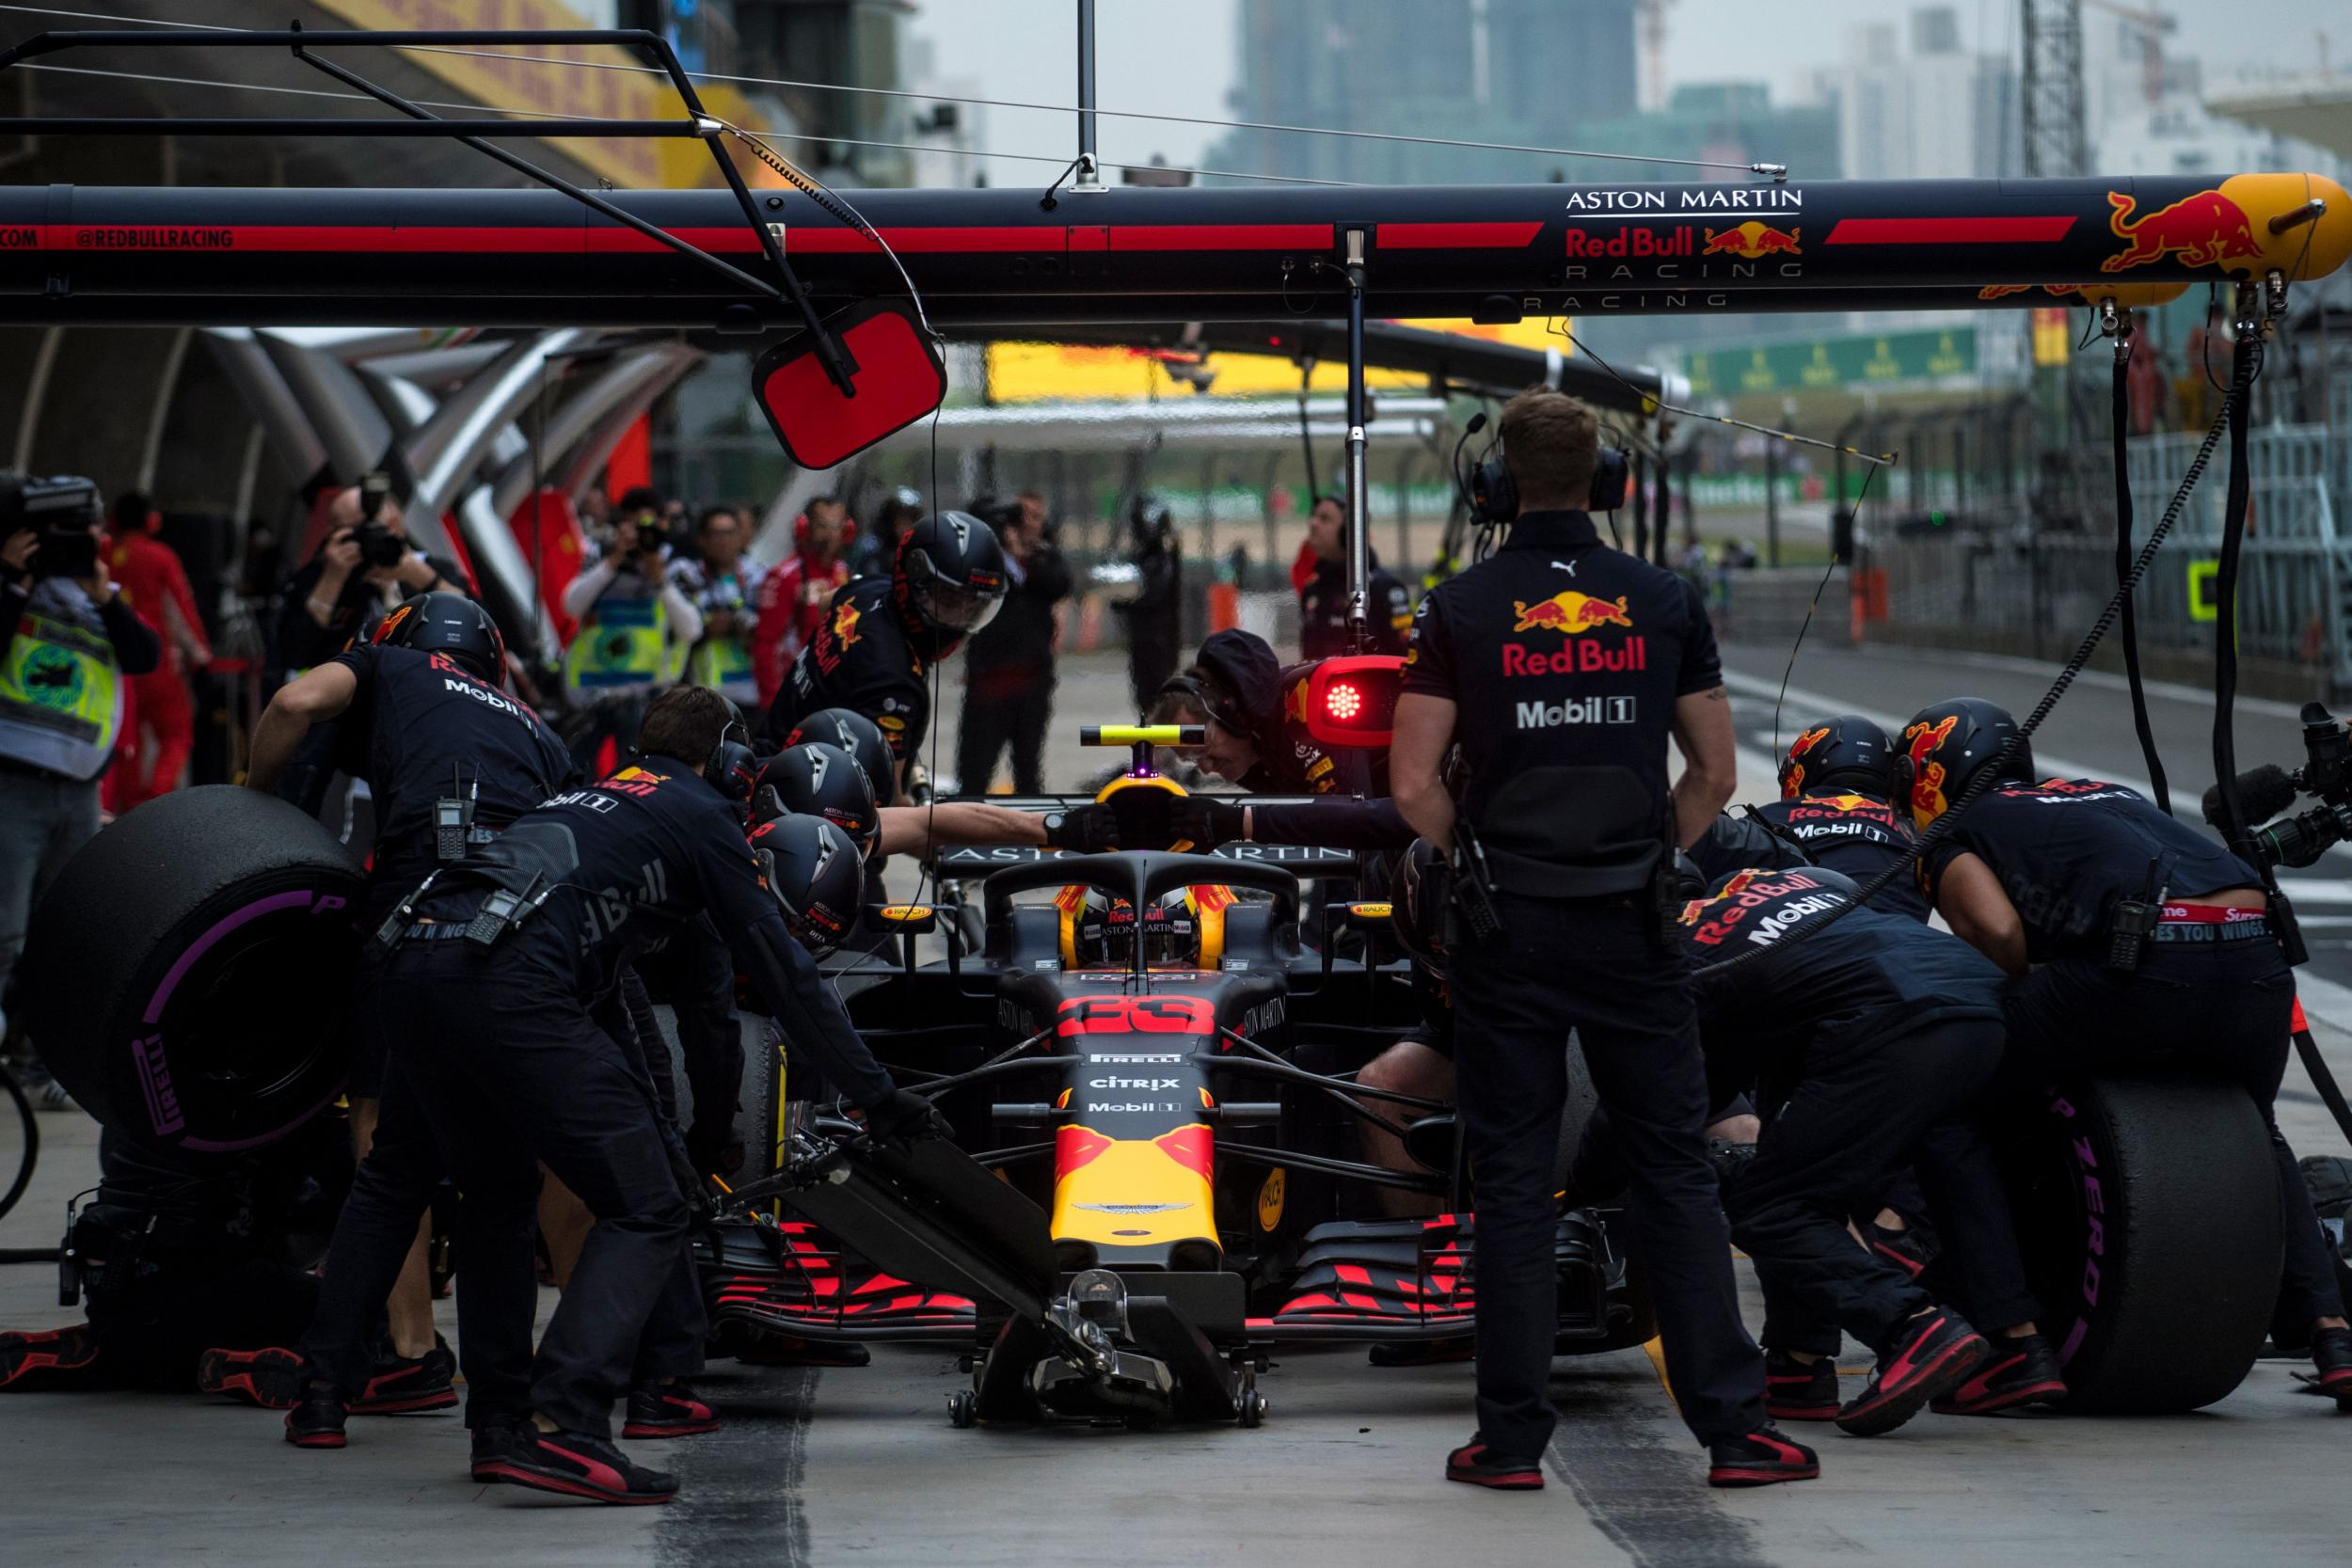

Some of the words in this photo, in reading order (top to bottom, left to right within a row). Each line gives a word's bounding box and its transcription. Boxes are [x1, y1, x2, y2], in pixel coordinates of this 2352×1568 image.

[1566, 191, 1665, 210] ASTON
[1680, 189, 1803, 208] MARTIN
[76, 230, 233, 248] @REDBULLRACING
[1565, 227, 1628, 258] Red
[1632, 225, 1692, 257] Bull
[1566, 263, 1803, 279] RACING
[1523, 293, 1726, 309] RACING
[1502, 637, 1574, 677] Red
[1578, 635, 1645, 673] Bull
[444, 678, 518, 716] Mobil
[1516, 696, 1603, 730] Mobil
[1793, 823, 1863, 839] Mobil
[947, 847, 1069, 861] AST
[1208, 847, 1352, 860] ARTIN
[1145, 906, 1164, 921] ull
[1693, 893, 1770, 945] Red
[1749, 873, 1825, 897] Bull
[1747, 895, 1834, 946] Mobil
[2181, 926, 2216, 942] YOU
[2221, 920, 2265, 941] WINGS
[1057, 994, 1216, 1038] 33
[1090, 1053, 1183, 1064] PIRELLI
[131, 1033, 186, 1136] PIRELLI
[1088, 1102, 1155, 1113] Mobil
[2072, 1135, 2106, 1308] ZERO
